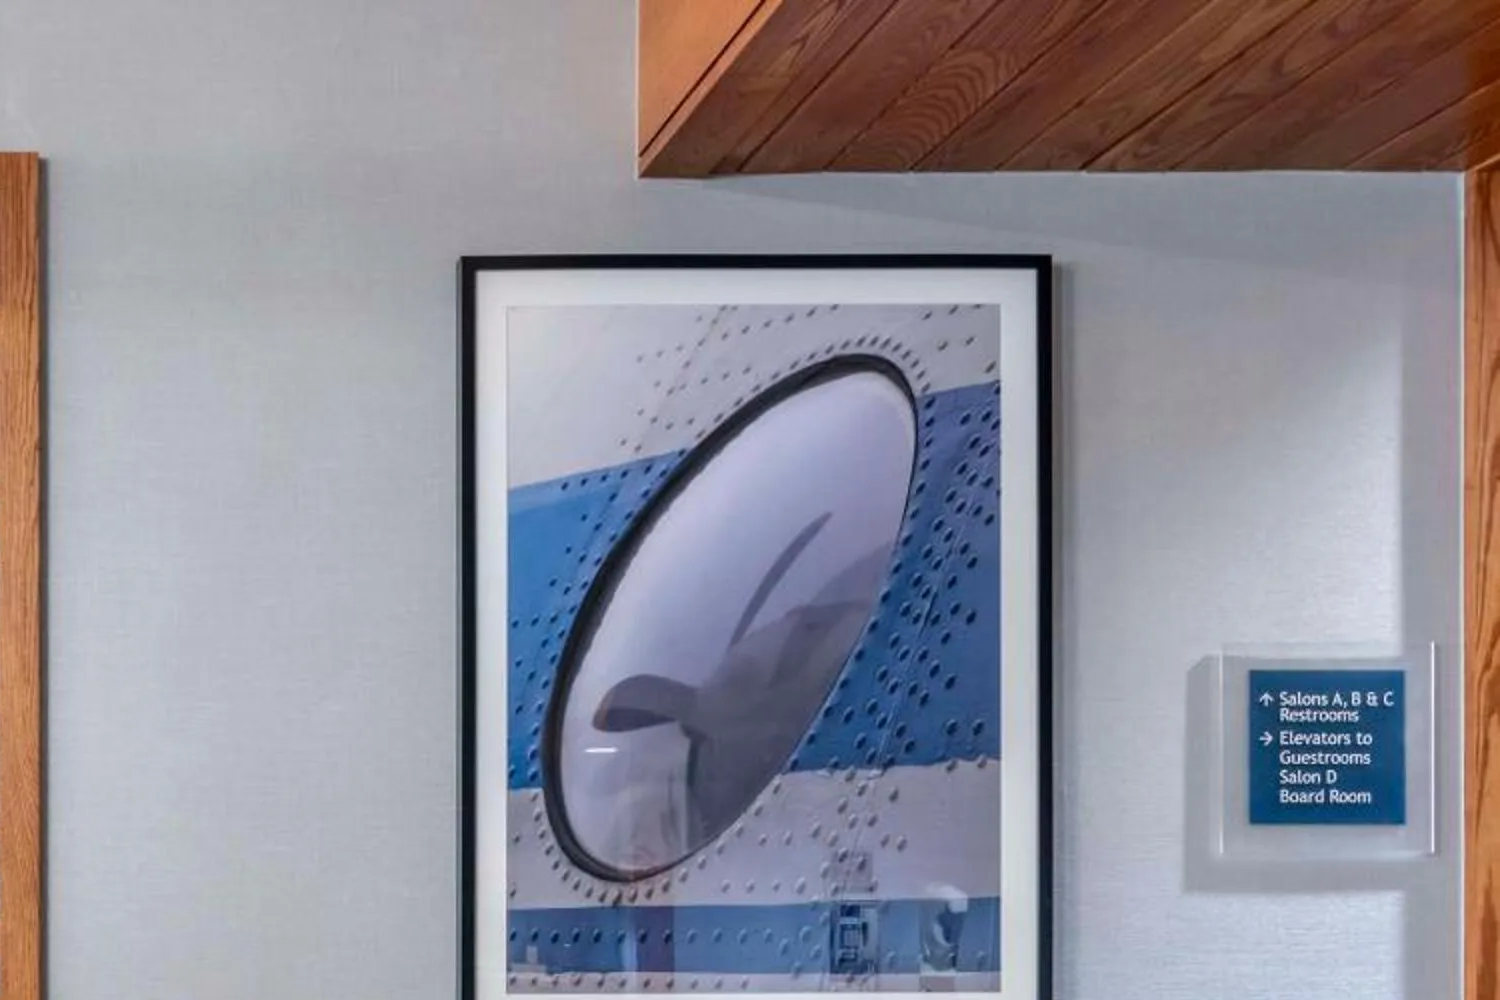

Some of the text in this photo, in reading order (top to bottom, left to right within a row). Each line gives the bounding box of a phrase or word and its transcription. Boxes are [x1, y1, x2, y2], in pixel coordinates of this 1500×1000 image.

[1280, 692, 1395, 708] Salons A, B & C
[1280, 708, 1359, 722] Restrooms
[1280, 731, 1373, 745] Elevators to
[1279, 750, 1371, 765] Guestrooms
[1279, 770, 1337, 785] Salon D
[1280, 789, 1372, 804] Board Room
